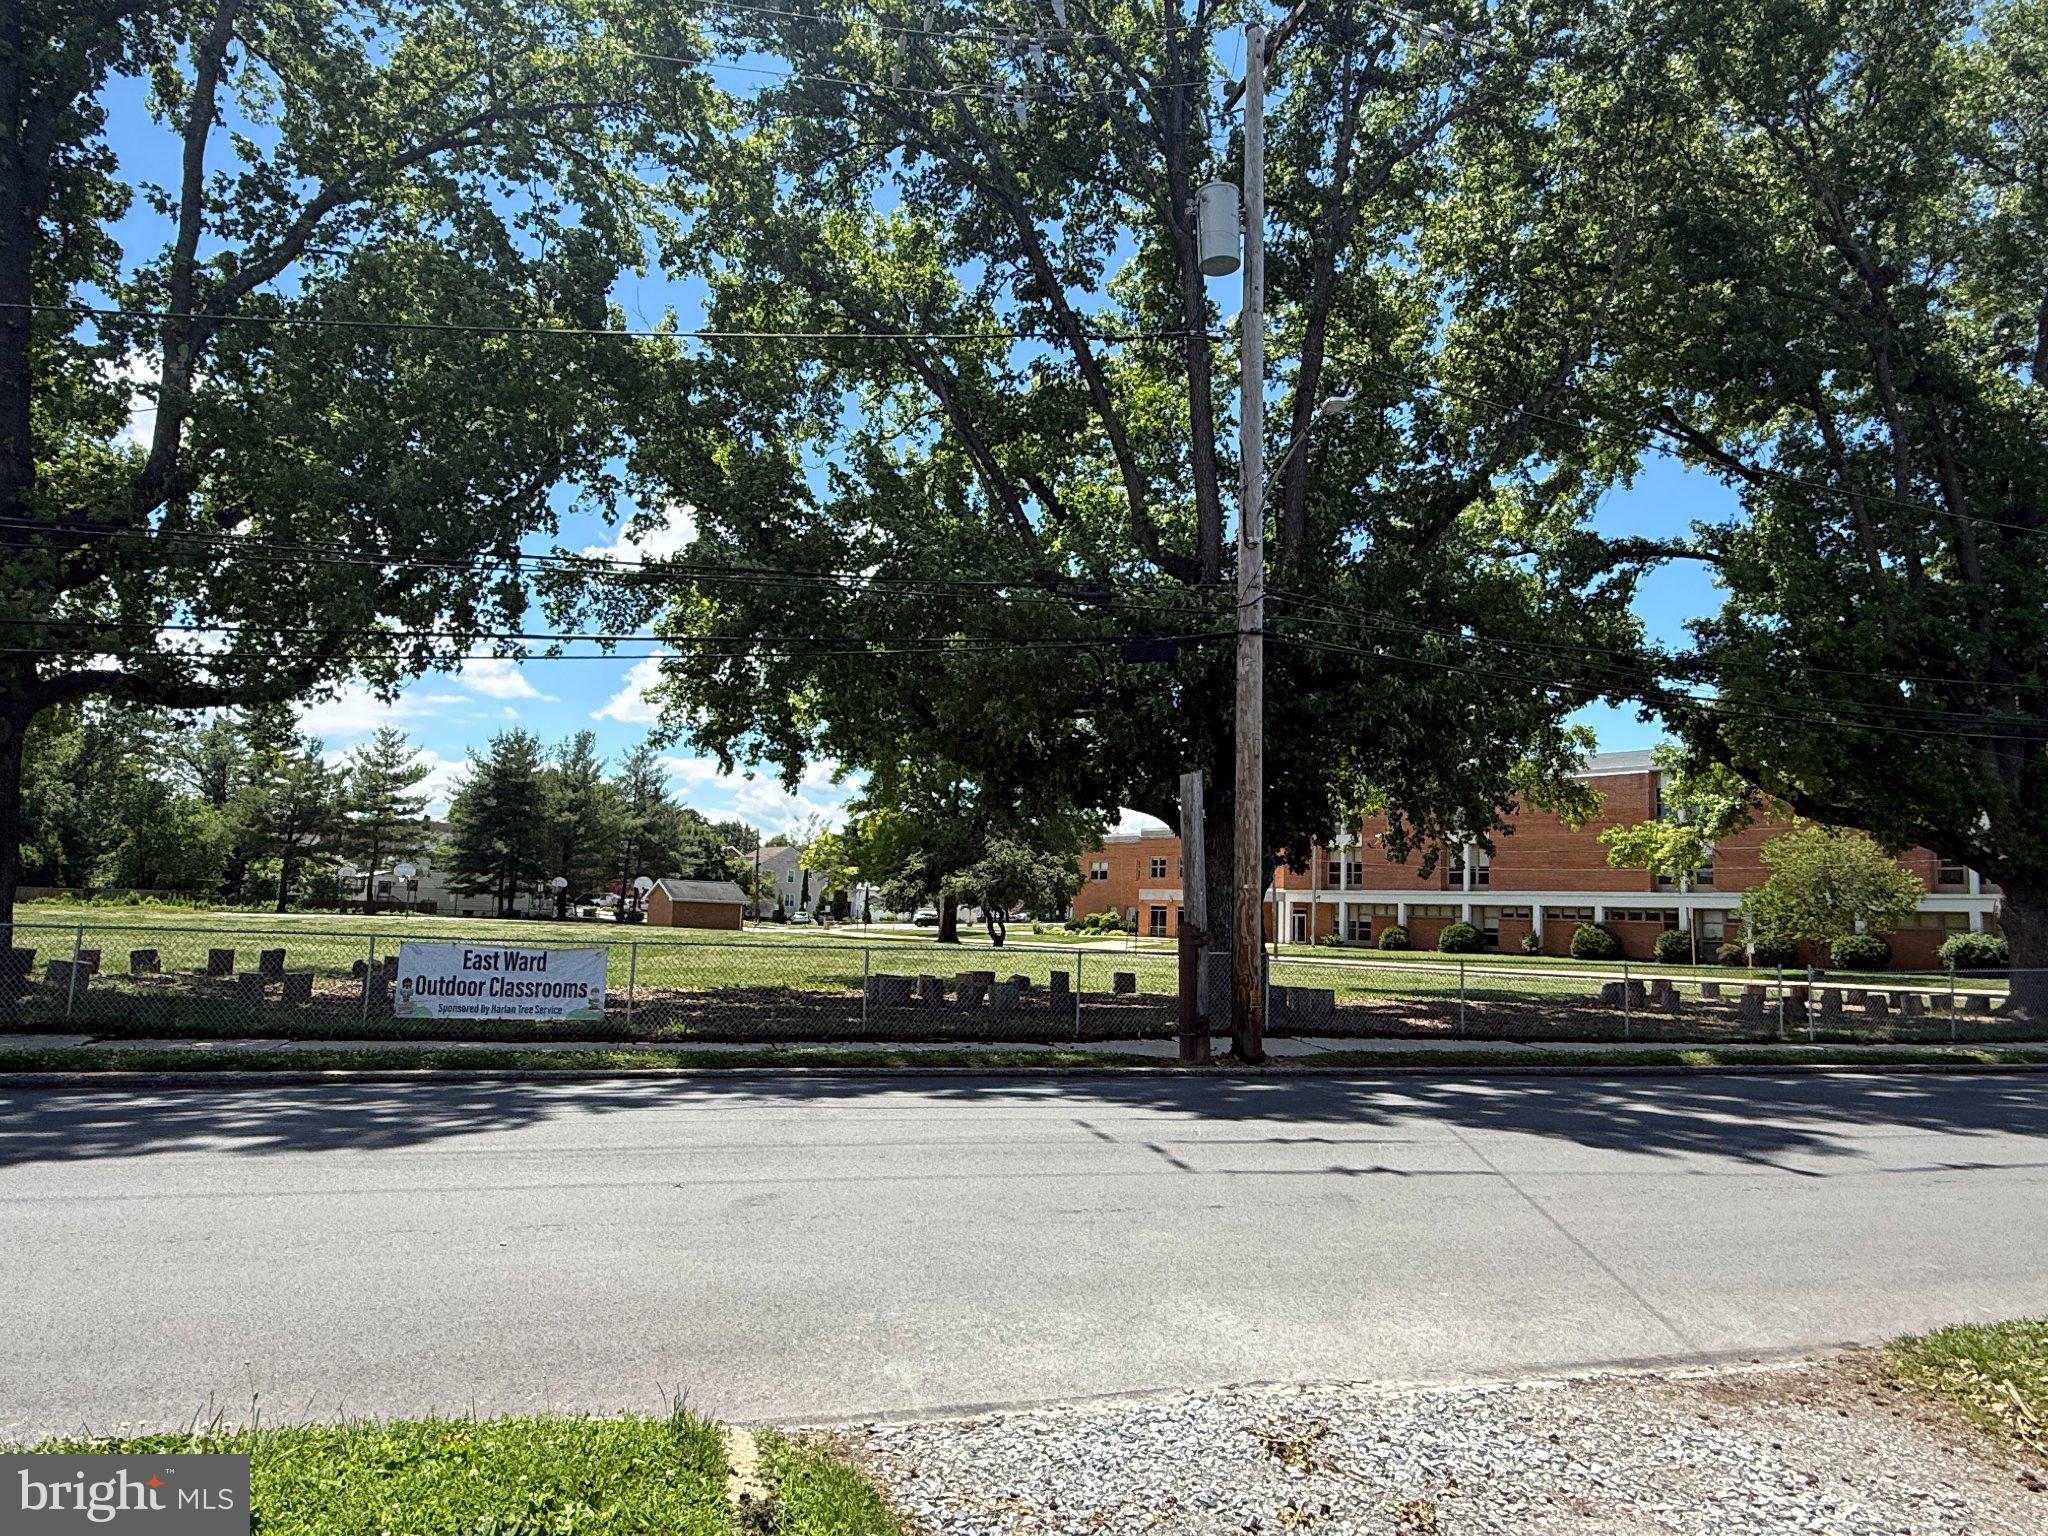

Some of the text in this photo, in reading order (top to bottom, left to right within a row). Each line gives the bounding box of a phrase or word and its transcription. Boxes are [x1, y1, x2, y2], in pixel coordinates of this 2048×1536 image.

[463, 950, 547, 972] East Ward
[415, 975, 588, 998] Outdoor Classrooms
[438, 1003, 479, 1014] Sponsored
[491, 1005, 516, 1014] Harlan
[518, 1005, 533, 1014] Tree
[535, 1005, 562, 1015] Service
